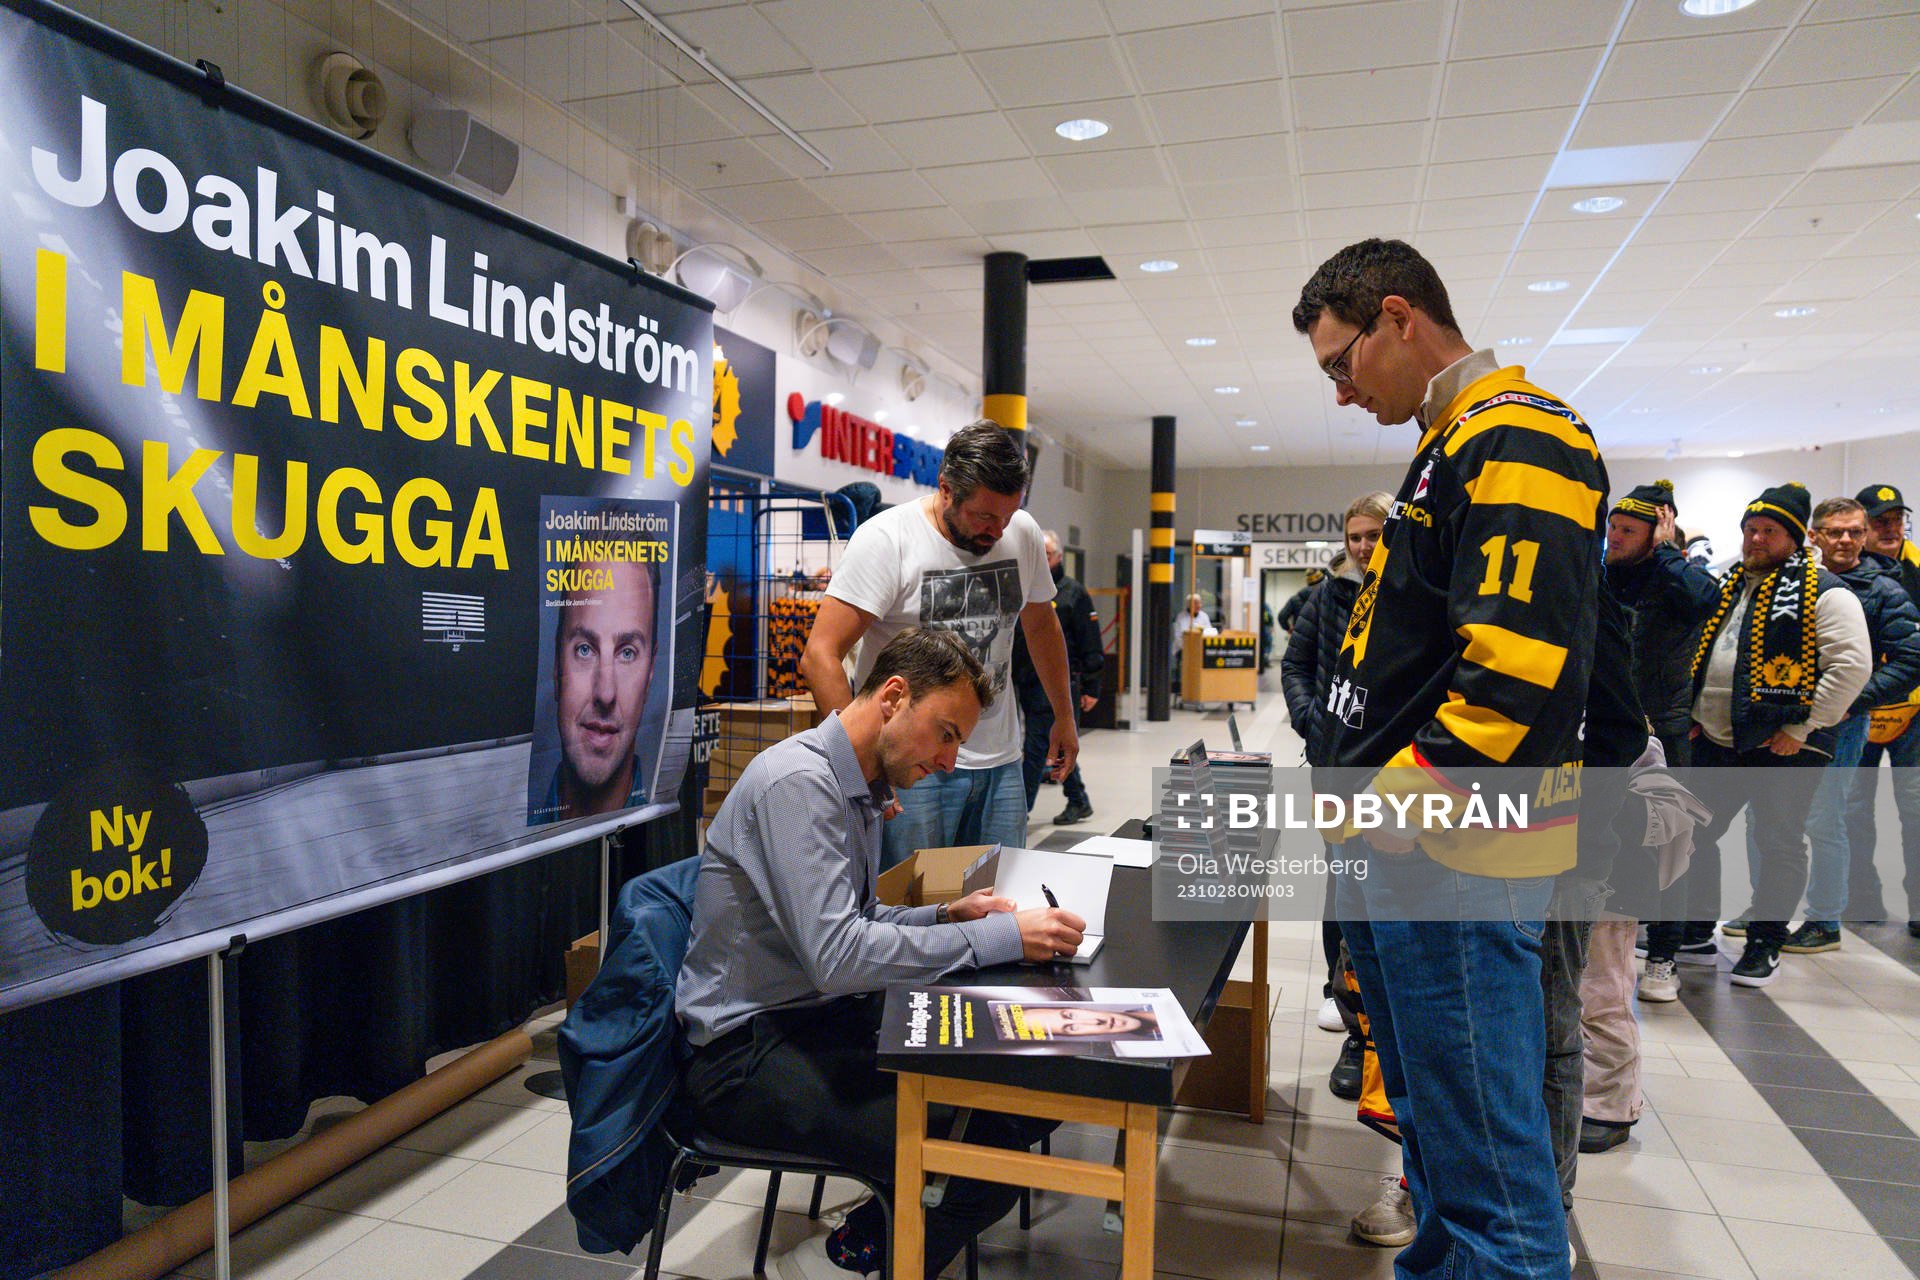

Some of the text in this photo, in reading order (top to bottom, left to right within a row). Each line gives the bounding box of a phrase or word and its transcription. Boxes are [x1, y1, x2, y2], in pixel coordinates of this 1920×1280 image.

[31, 95, 699, 398] Joakim Lindström
[35, 248, 696, 488] I MÅNSKENETS
[28, 427, 510, 571] SKUGGA
[545, 509, 669, 533] Joakim Lindström
[1237, 512, 1344, 533] SEKTION
[546, 534, 669, 563] I MÅNSKENETS
[1264, 547, 1335, 564] SEKTIO
[1478, 534, 1540, 603] 11
[545, 568, 615, 592] SKUGGA
[90, 805, 152, 852] Ny
[70, 848, 172, 911] bok!
